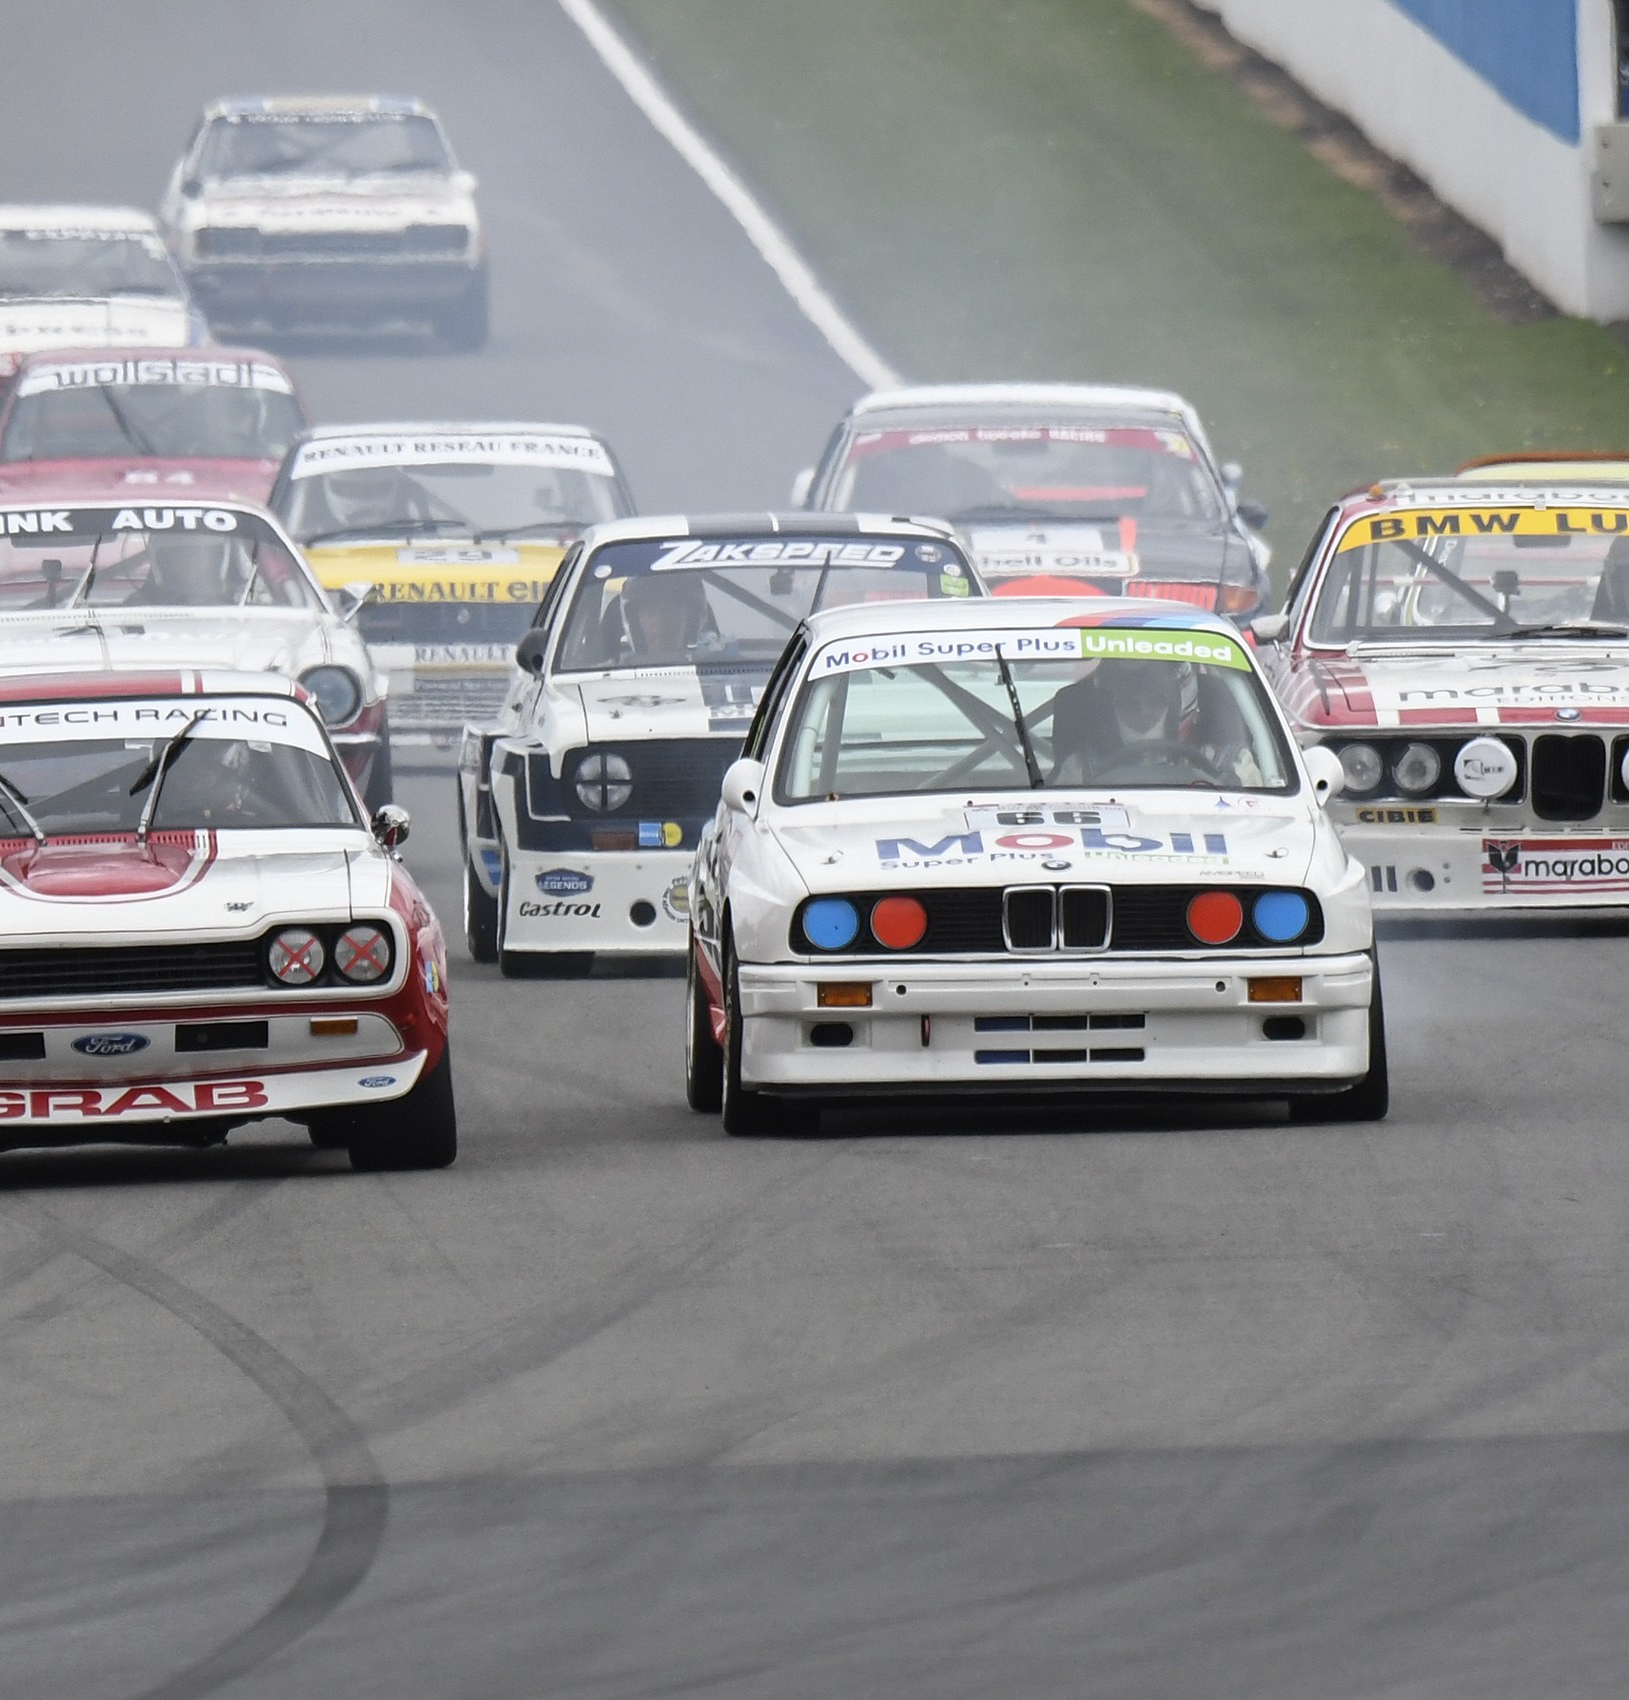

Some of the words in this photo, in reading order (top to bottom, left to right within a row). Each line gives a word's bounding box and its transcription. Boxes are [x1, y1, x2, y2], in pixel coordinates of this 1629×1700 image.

[113, 509, 237, 533] AUTO
[1370, 513, 1520, 541] BMW
[651, 540, 906, 571] ZAKSPEED
[982, 556, 1043, 567] hell
[1055, 555, 1118, 568] Oils
[373, 580, 500, 602] RENAULT
[825, 644, 907, 669] Mobil
[917, 639, 1006, 658] Super
[1017, 637, 1076, 653] Plus
[1084, 635, 1233, 662] Unleaded
[134, 708, 288, 727] RACING
[996, 811, 1102, 826] 66
[1358, 809, 1435, 824] CIBIE
[876, 828, 1228, 862] Mobil
[880, 856, 979, 870] Super
[519, 901, 601, 918] Castrol
[88, 1036, 131, 1053] Ford
[364, 1077, 390, 1087] Ford
